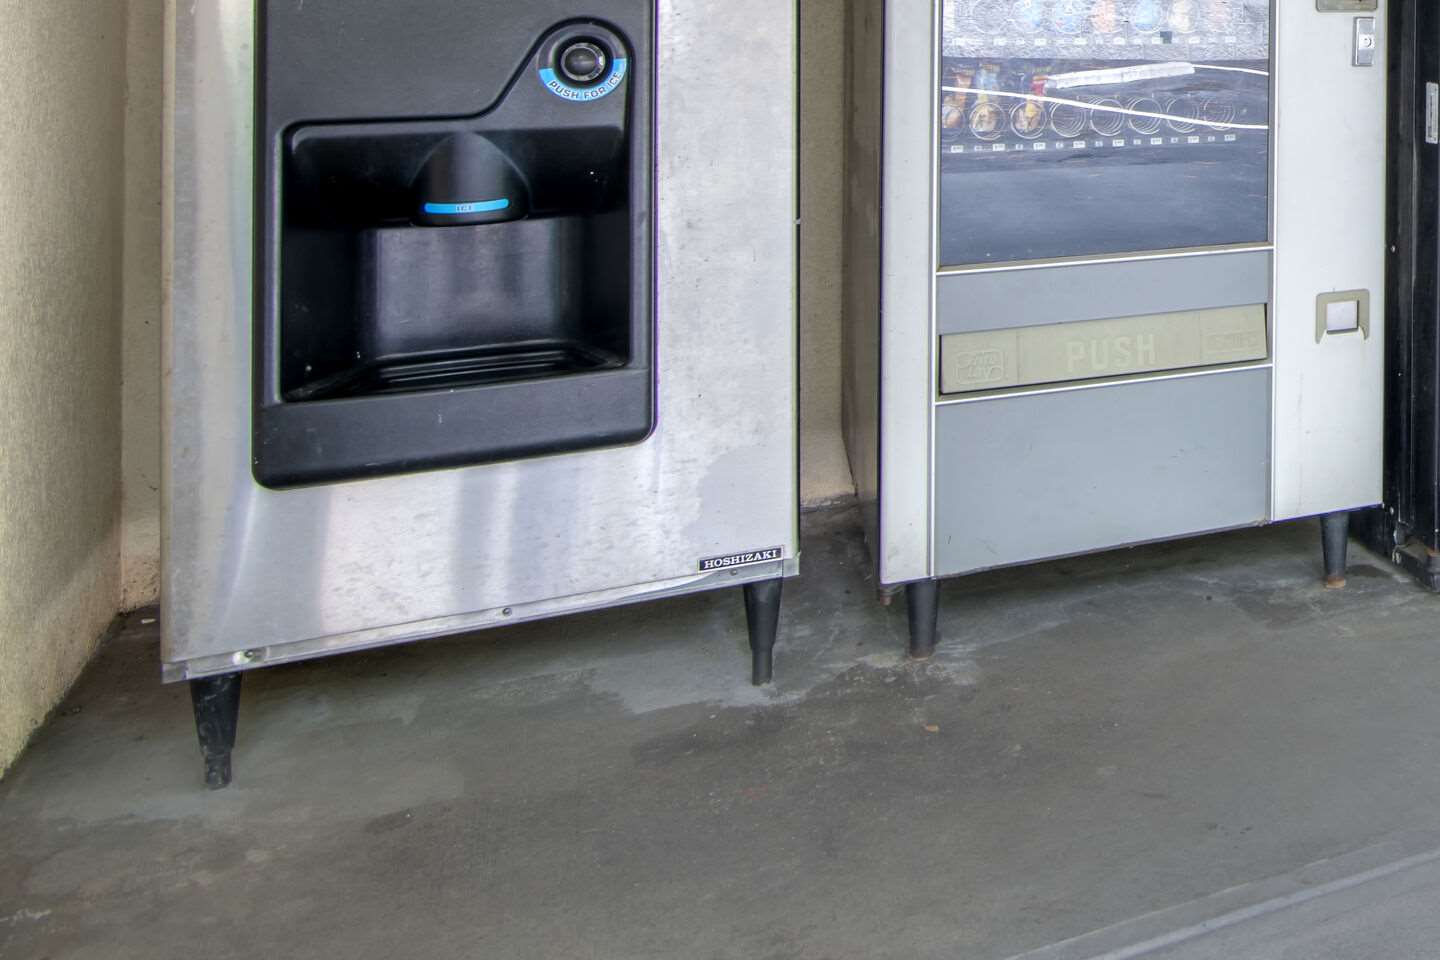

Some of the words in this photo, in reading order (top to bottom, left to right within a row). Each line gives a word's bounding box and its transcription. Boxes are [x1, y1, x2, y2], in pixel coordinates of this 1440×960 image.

[549, 79, 580, 100] PUSH
[583, 87, 607, 100] FOR
[607, 72, 623, 90] ICE
[1066, 333, 1157, 373] PUSH
[703, 549, 778, 570] HOSHIZAKI
